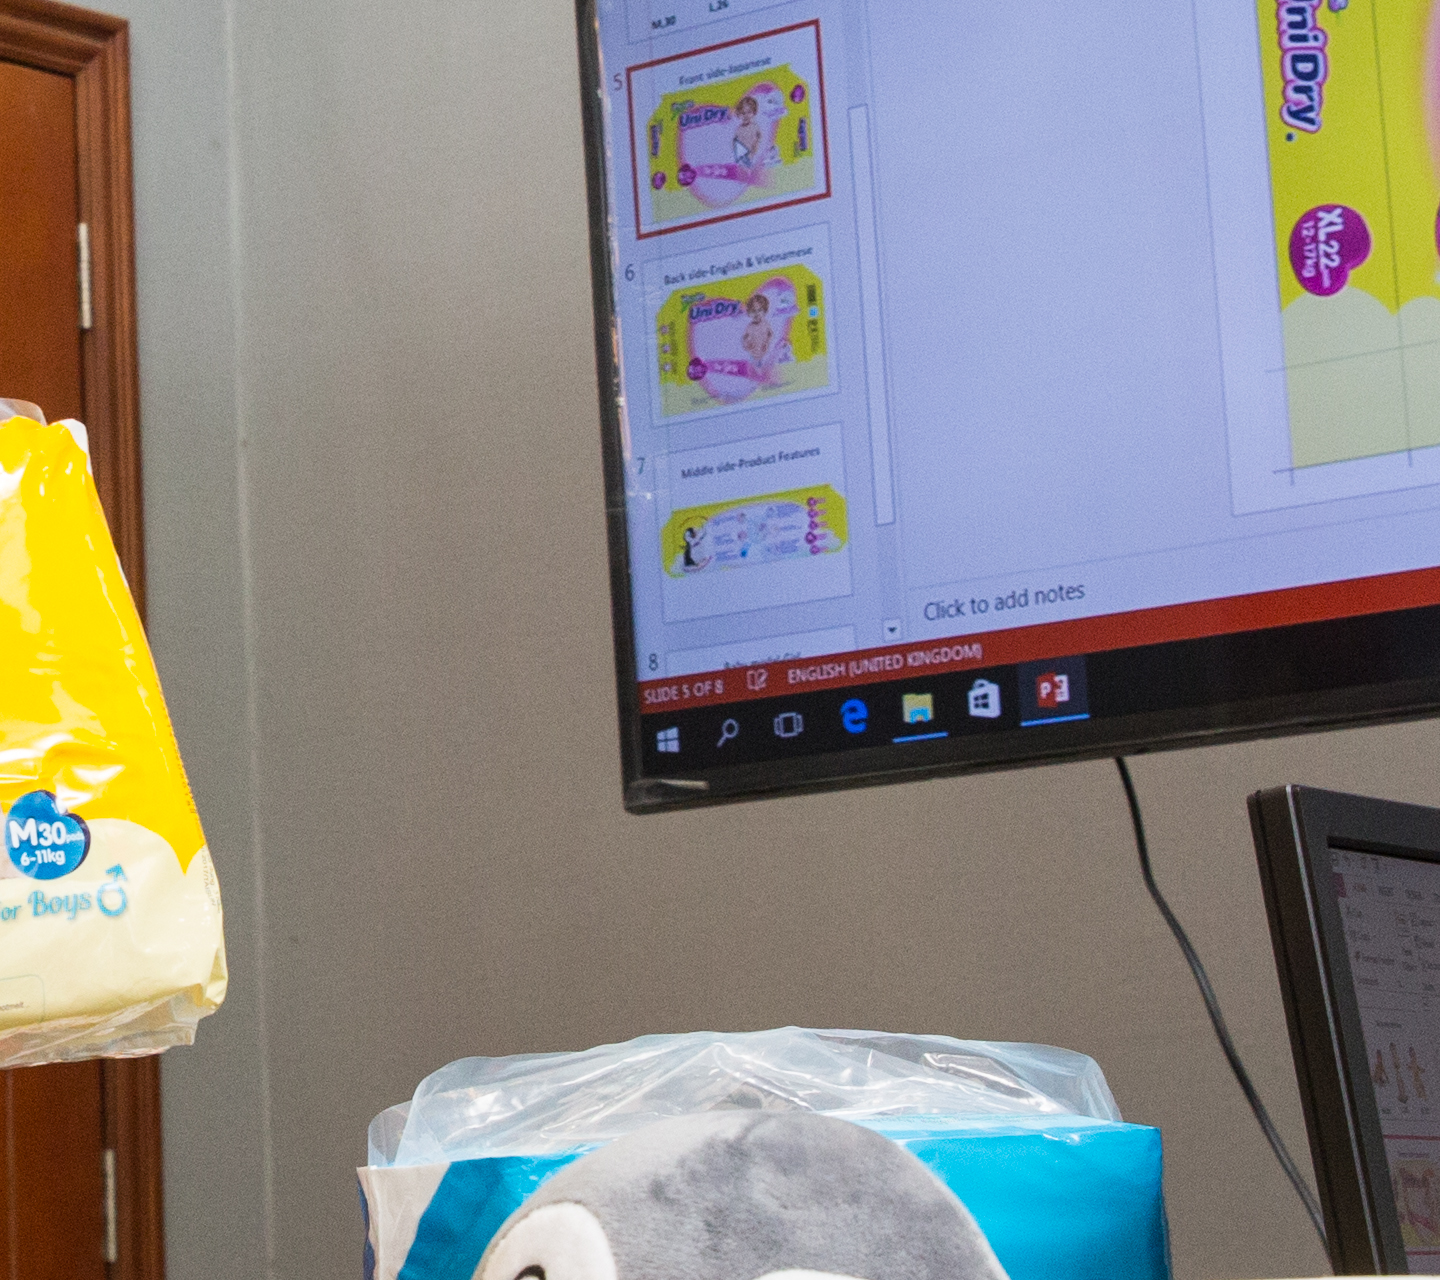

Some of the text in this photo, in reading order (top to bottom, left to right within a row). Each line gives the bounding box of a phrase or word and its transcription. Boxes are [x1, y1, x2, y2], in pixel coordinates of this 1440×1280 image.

[1299, 220, 1317, 280] 12-17kg
[624, 263, 636, 282] 6
[636, 456, 646, 475] 7
[922, 580, 1087, 624] Click to add notes
[647, 653, 659, 671] 8
[787, 660, 846, 684] ENGLISH
[848, 653, 903, 679] (UNITED
[905, 642, 984, 671] KINGDOM)
[643, 680, 713, 704] SLIDE OF
[19, 847, 67, 868] 6-11kg
[26, 889, 94, 922] Boys
